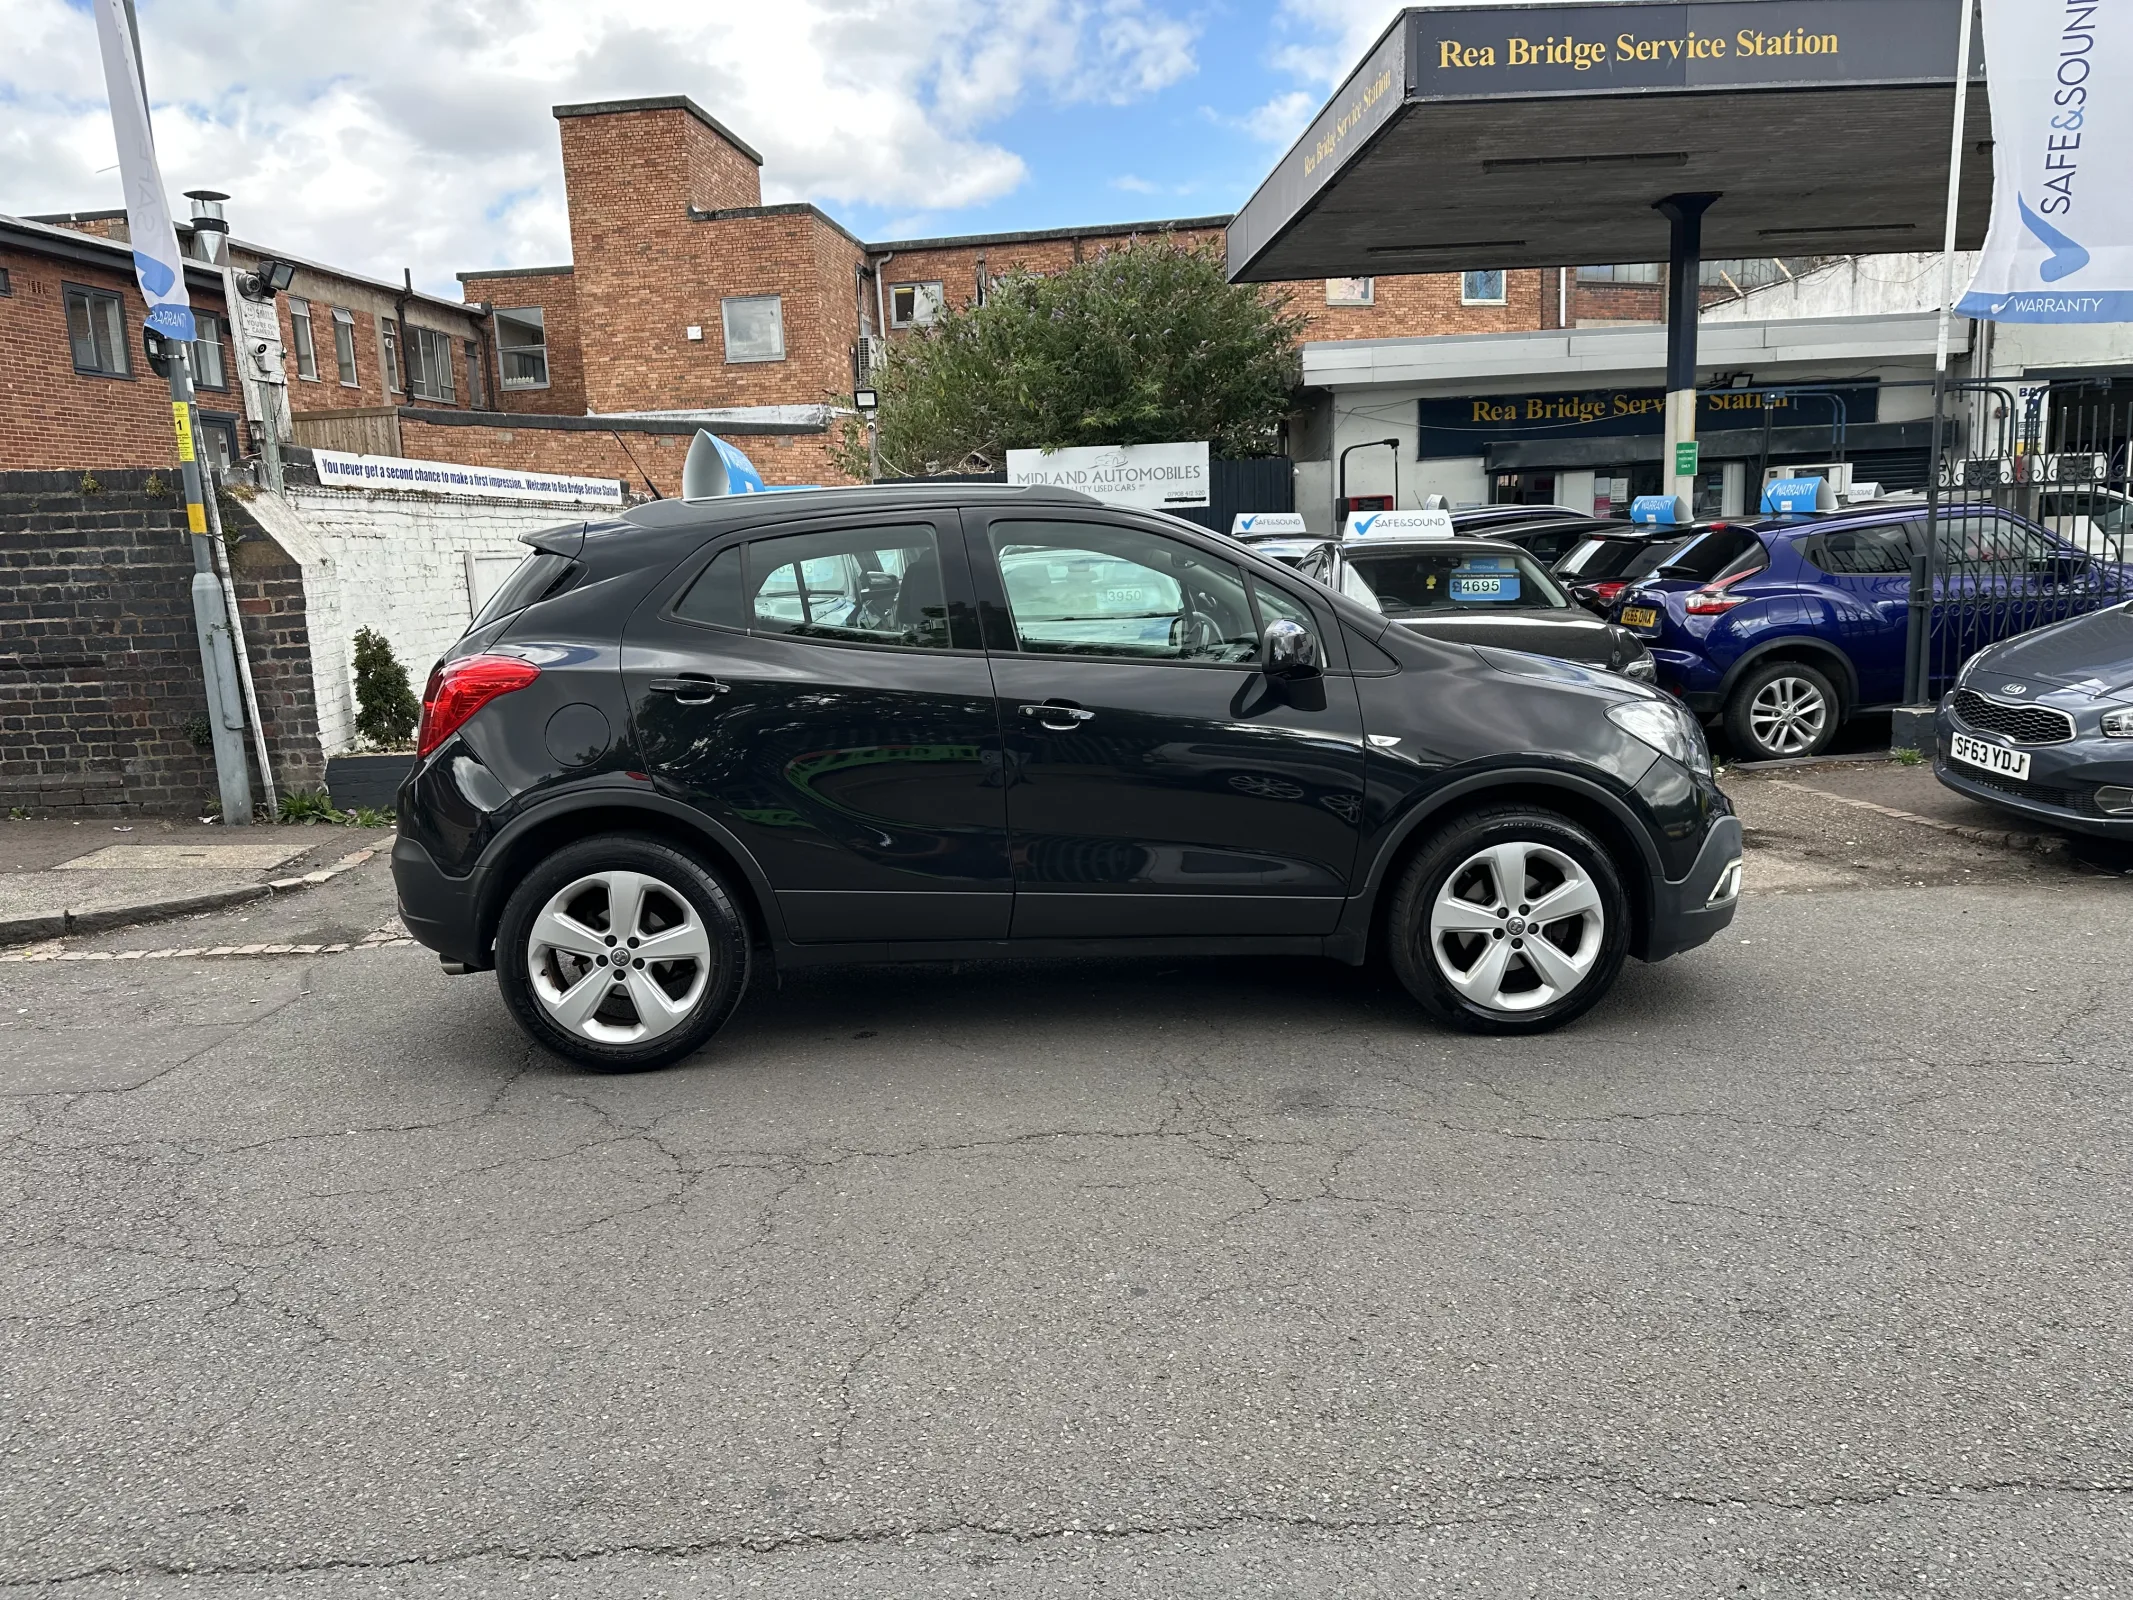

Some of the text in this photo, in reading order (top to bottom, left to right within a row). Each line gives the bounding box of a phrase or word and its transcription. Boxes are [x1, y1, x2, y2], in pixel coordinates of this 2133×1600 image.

[1437, 27, 1839, 71] Rea Bridge Service Station
[2039, 0, 2100, 215] SAFE&SOUN
[1304, 69, 1391, 178] Rea Bridge Service Station
[2014, 298, 2104, 312] WARRANTY
[1471, 400, 1517, 422] Rea
[1526, 398, 1606, 422] Bridge
[1613, 394, 1668, 415] Serv
[176, 419, 183, 431] 1
[322, 458, 339, 474] You
[339, 462, 363, 477] never
[365, 464, 379, 479] get
[380, 467, 386, 478] a
[386, 466, 414, 481] second
[414, 468, 441, 483] chance
[441, 471, 449, 483] to
[450, 471, 469, 486] make
[469, 476, 474, 485] a
[474, 473, 489, 487] first
[525, 478, 551, 492] Welcome
[551, 481, 558, 492] to
[557, 482, 568, 494] Rea
[568, 482, 585, 495] Bridge
[584, 483, 602, 497] Service
[602, 485, 619, 498] Station
[1016, 465, 1201, 485] MIDLAND AUTOMOBILES
[1094, 484, 1113, 493] USED
[1114, 483, 1136, 492] CARS
[1775, 483, 1817, 496] WARRANTY
[1641, 500, 1673, 511] WARRANTY
[1254, 518, 1301, 526] SAFE&SOUND
[1374, 517, 1446, 528] SAFE&SOUND
[1108, 590, 1142, 602] 3950
[2003, 683, 2023, 693] KIA
[1956, 736, 2024, 773] SF63 YDJ
